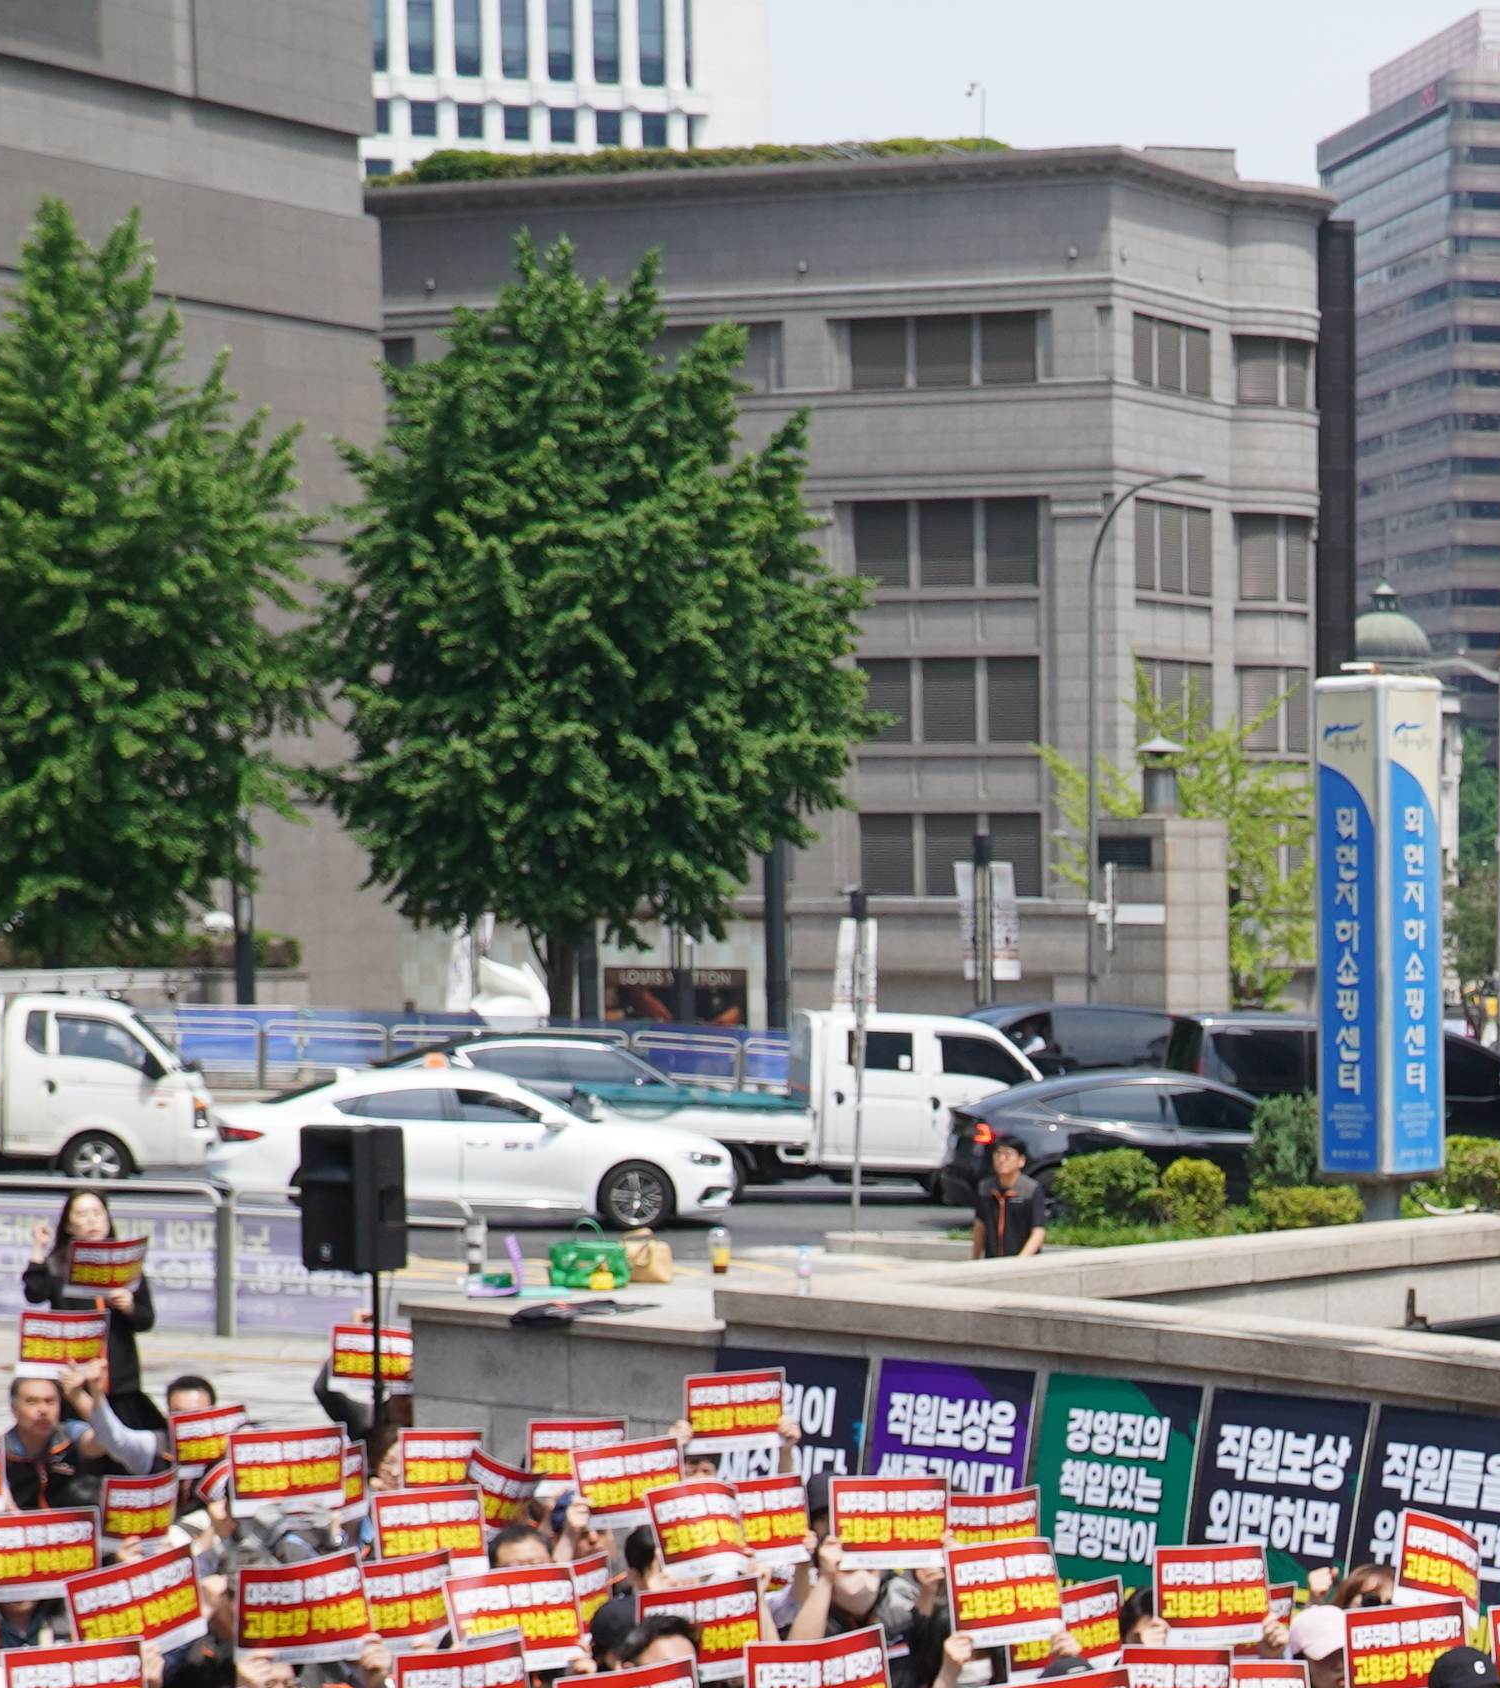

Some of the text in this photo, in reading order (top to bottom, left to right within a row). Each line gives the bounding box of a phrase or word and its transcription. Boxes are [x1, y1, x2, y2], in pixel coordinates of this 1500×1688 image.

[619, 969, 664, 985] LOUIS
[1335, 807, 1360, 1095] 회현지하쇼핑센터
[1403, 805, 1426, 1093] 회현지하쇼핑센터
[888, 1393, 1017, 1455] 직원보상은
[1066, 1407, 1170, 1460] 경영진의
[1060, 1458, 1163, 1513] 책임있는
[1217, 1424, 1352, 1491] 직원보상
[1055, 1510, 1158, 1565] 결정만이
[1208, 1490, 1340, 1558] 외면하면
